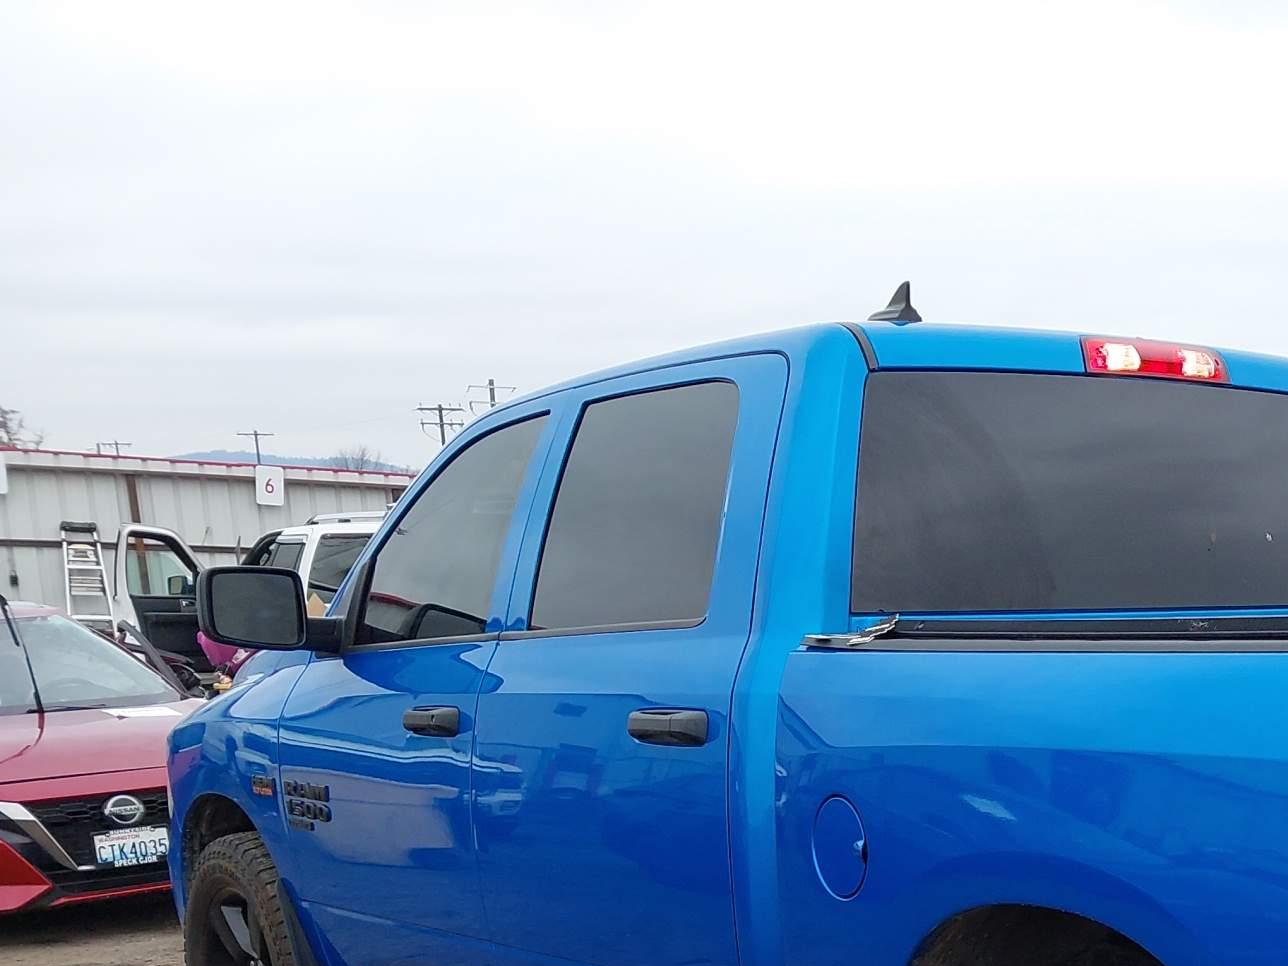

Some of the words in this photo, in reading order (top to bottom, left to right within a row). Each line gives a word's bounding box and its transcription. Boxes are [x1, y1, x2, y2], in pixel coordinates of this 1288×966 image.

[265, 477, 275, 494] 6
[108, 806, 140, 816] NISSAN
[286, 798, 332, 822] 1500
[98, 837, 168, 863] CTK4035
